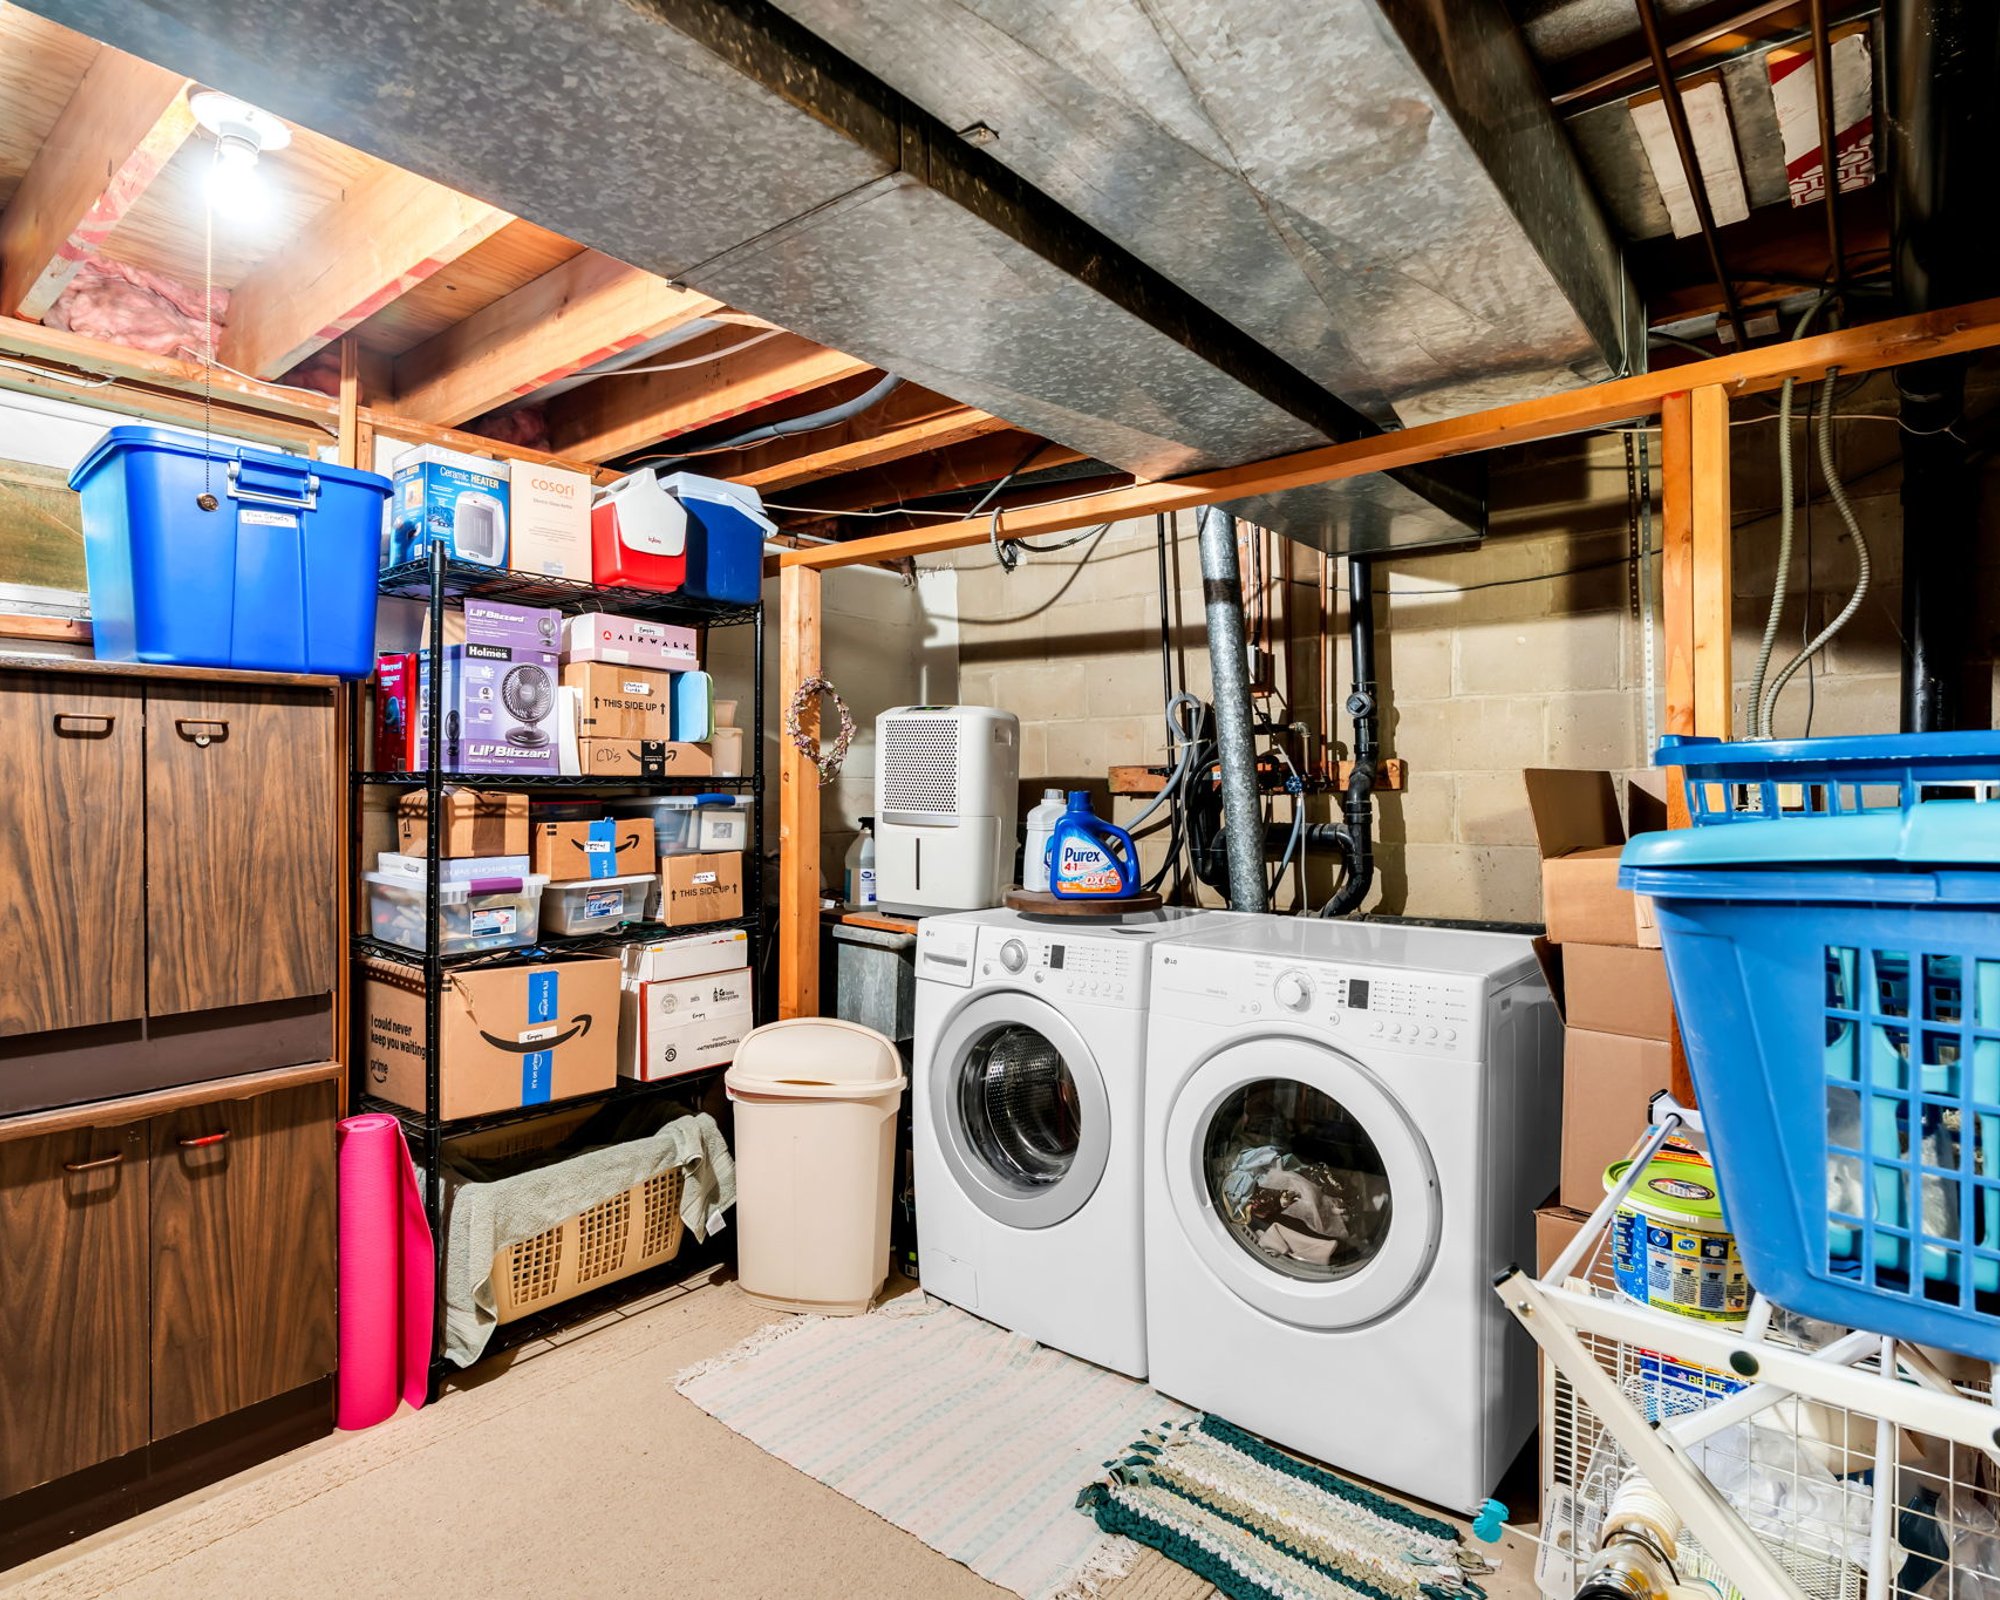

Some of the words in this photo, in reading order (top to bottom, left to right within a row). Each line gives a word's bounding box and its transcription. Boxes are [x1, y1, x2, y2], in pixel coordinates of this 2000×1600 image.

[440, 466, 470, 481] Ceramic
[471, 474, 499, 489] HEATER
[531, 477, 575, 496] cosori
[486, 611, 525, 623] Blizzard
[618, 634, 689, 650] AIRWALK
[468, 645, 508, 659] Holmes
[603, 698, 622, 709] THIS
[624, 701, 643, 711] SIDE
[646, 702, 657, 712] UP
[494, 745, 550, 759] Blizzard
[596, 747, 621, 762] CD's
[1064, 847, 1101, 862] Purex
[680, 888, 698, 898] THIS
[699, 885, 718, 896] SIDE
[719, 884, 730, 894] UP
[374, 1017, 392, 1032] could
[393, 1022, 412, 1036] never
[371, 1029, 386, 1048] keep
[387, 1037, 399, 1050] you
[400, 1040, 426, 1060] waiting
[371, 1058, 388, 1074] prime
